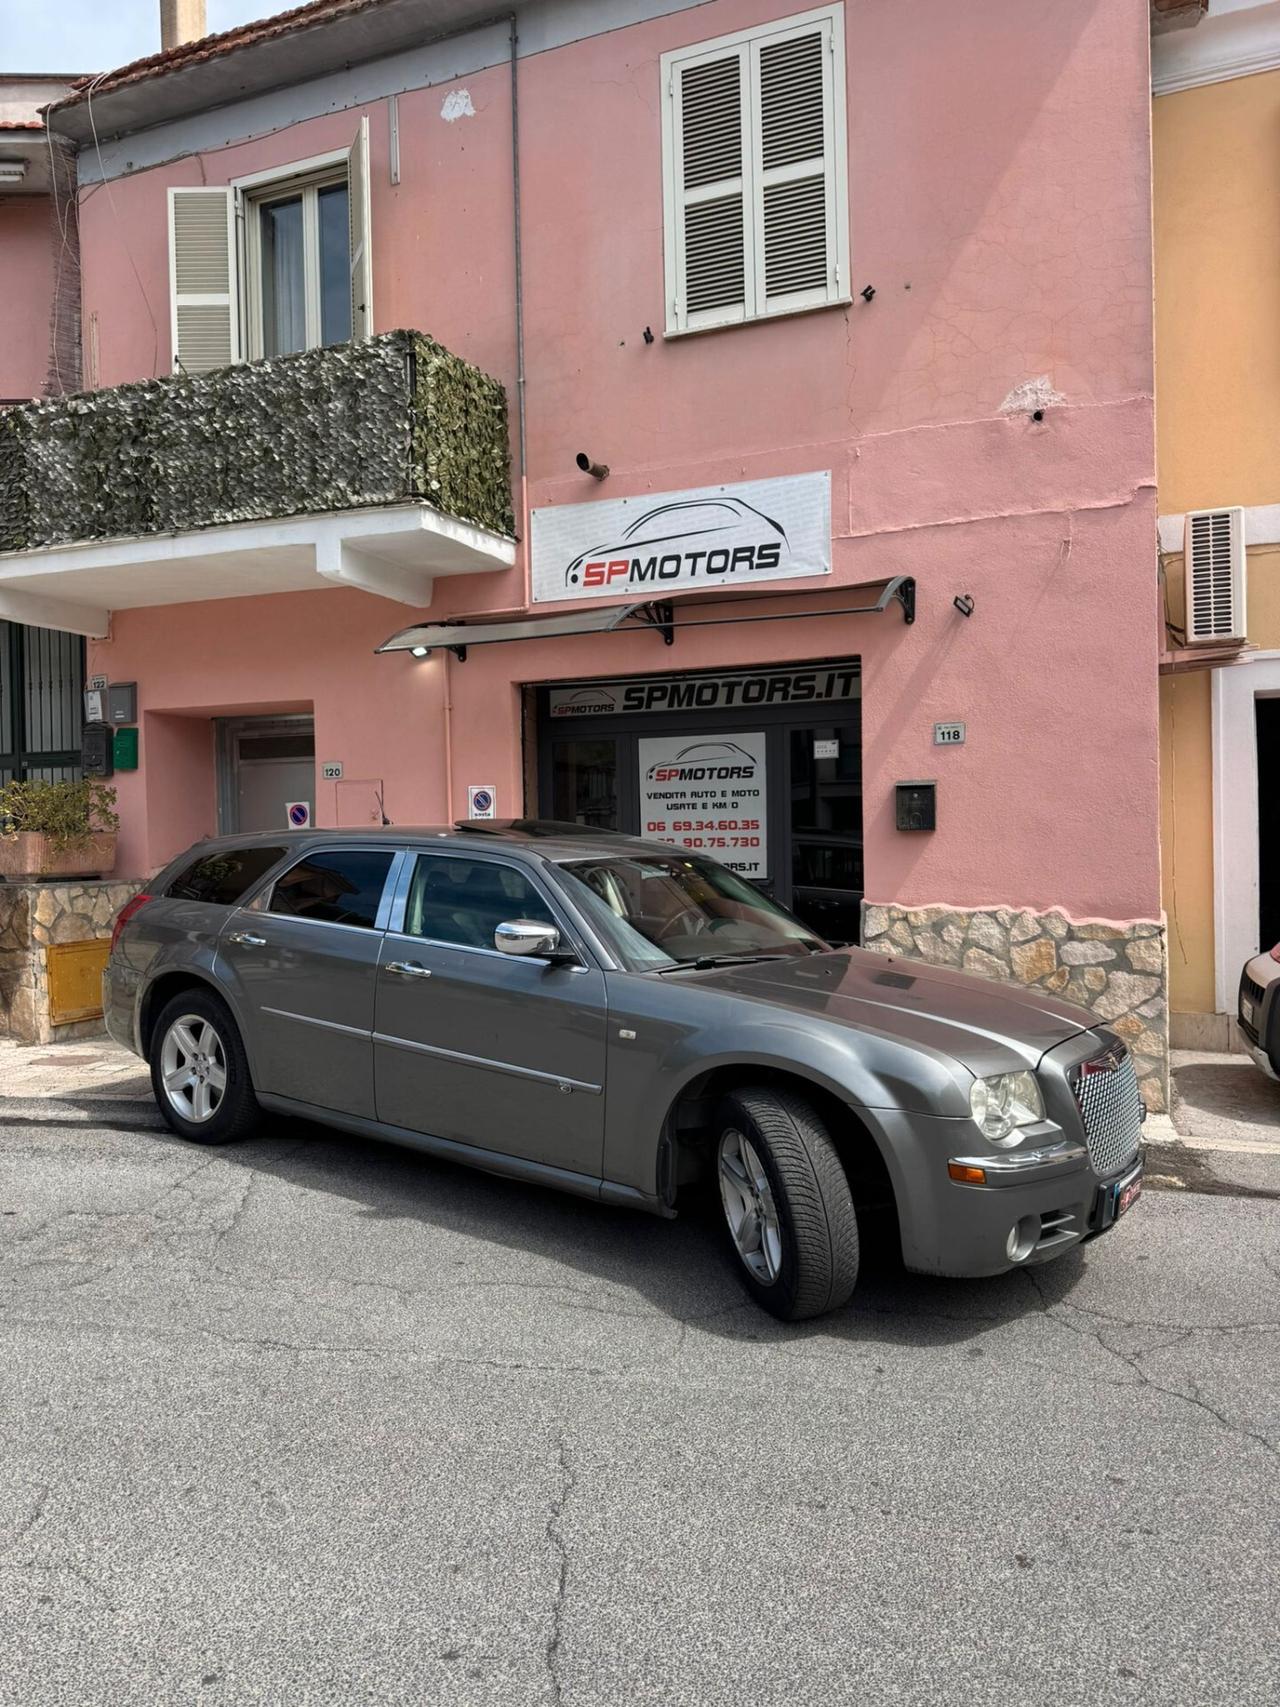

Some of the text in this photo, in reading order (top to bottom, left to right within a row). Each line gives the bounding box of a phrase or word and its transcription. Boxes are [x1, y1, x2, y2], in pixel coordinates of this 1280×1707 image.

[583, 543, 781, 586] SPMOTORS
[93, 681, 105, 689] 122
[622, 673, 860, 711] SPMOTORS.IT
[557, 703, 615, 715] SPMOTORS
[940, 730, 960, 740] 118
[325, 768, 341, 777] 120
[655, 766, 754, 782] SPMOTORS
[646, 791, 686, 800] VENDITA
[690, 790, 716, 798] AUTO
[731, 789, 760, 797] MOTO
[666, 803, 697, 811] USATE
[647, 819, 760, 832] 06 69.34.60.35
[683, 837, 760, 848] 90.75.730
